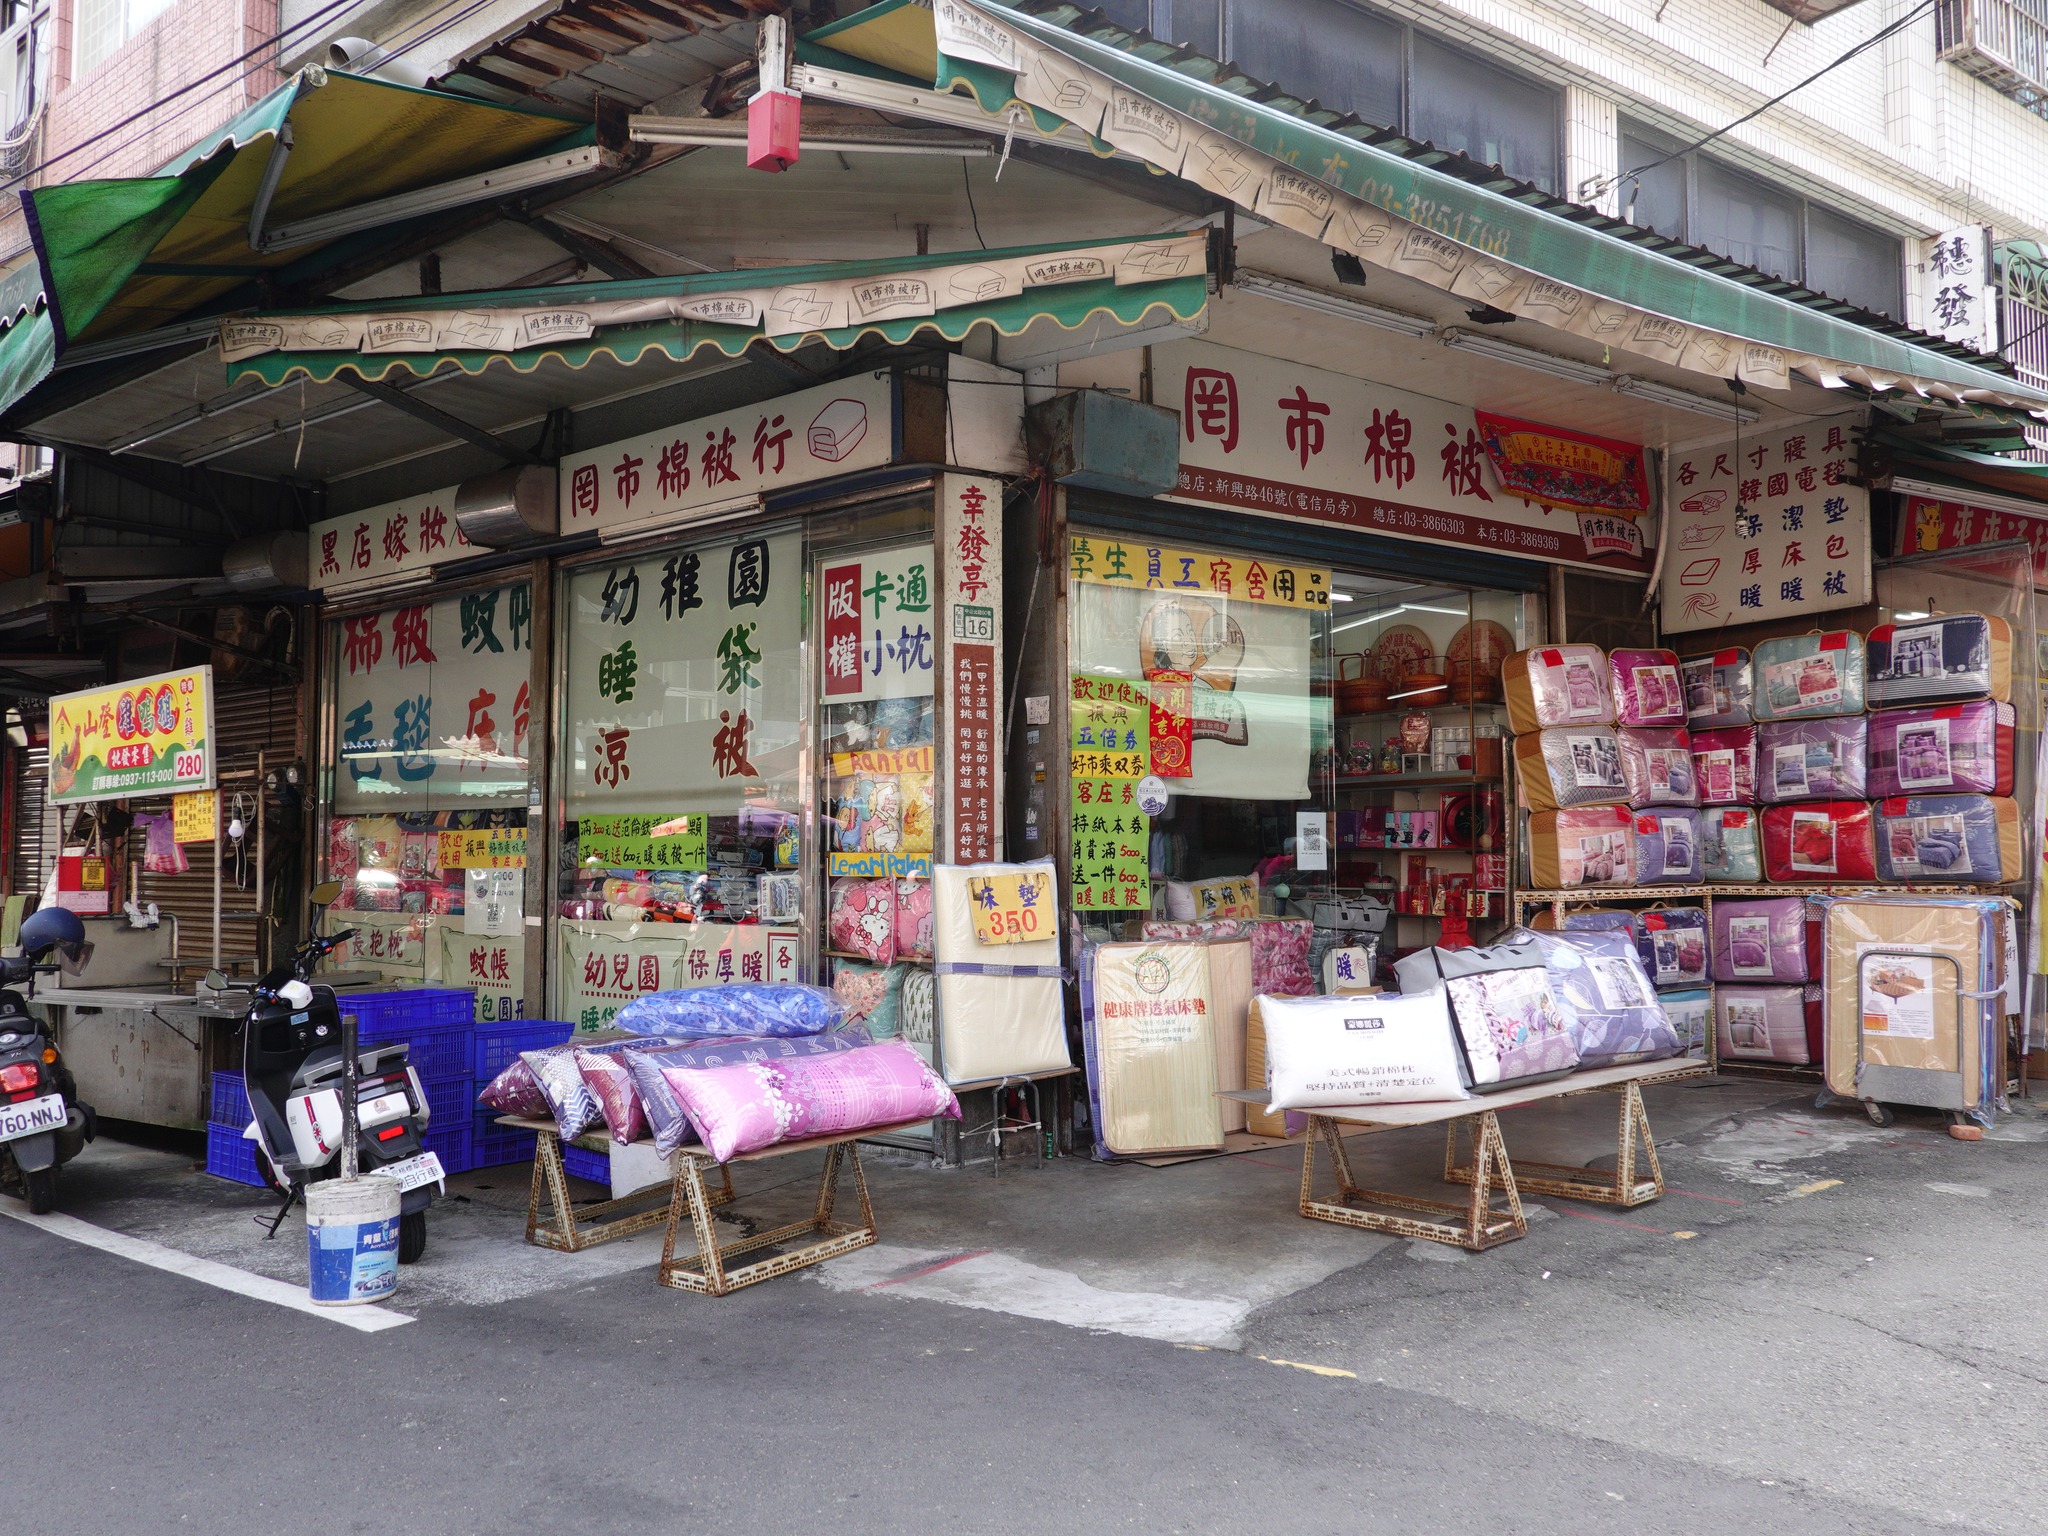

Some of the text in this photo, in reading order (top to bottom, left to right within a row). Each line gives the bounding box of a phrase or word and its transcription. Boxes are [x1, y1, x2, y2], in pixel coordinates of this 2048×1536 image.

[860, 283, 921, 304] 罔市棉被行
[1185, 365, 1552, 515] 罔市棉被
[570, 414, 793, 519] 罔市棉被行
[957, 485, 991, 602] 幸發亭
[1584, 518, 1636, 543] 罔市棉被行
[1741, 534, 1849, 574] 厚床包
[601, 539, 770, 626] 幼稚園
[862, 564, 932, 620] 卡通
[1740, 570, 1848, 608] 暖暖被
[828, 579, 859, 679] 版權
[969, 620, 987, 636] 16
[599, 622, 762, 705] 睡袋
[864, 624, 933, 676] 小枕
[1073, 677, 1149, 707] 歡迎使用
[1087, 704, 1128, 725] 振興
[594, 708, 759, 790] 涼被
[1078, 726, 1138, 750] 五倍券
[177, 754, 201, 777] 280
[960, 658, 973, 859] 我們慢慢挑 罔市好好逛 買一床好被
[1077, 780, 1134, 805] 客庄券
[1072, 813, 1143, 835] 持紙本券
[831, 854, 884, 875] Lemari
[979, 884, 1039, 909] 床墊
[1077, 886, 1141, 907] 暖暖被
[989, 909, 1038, 936] 350
[470, 946, 510, 980] 蚊帳
[584, 951, 660, 993] 幼兒園
[776, 946, 793, 969] 各
[1337, 953, 1355, 981] 暖
[1104, 998, 1206, 1018] 健康牌透氣床墊
